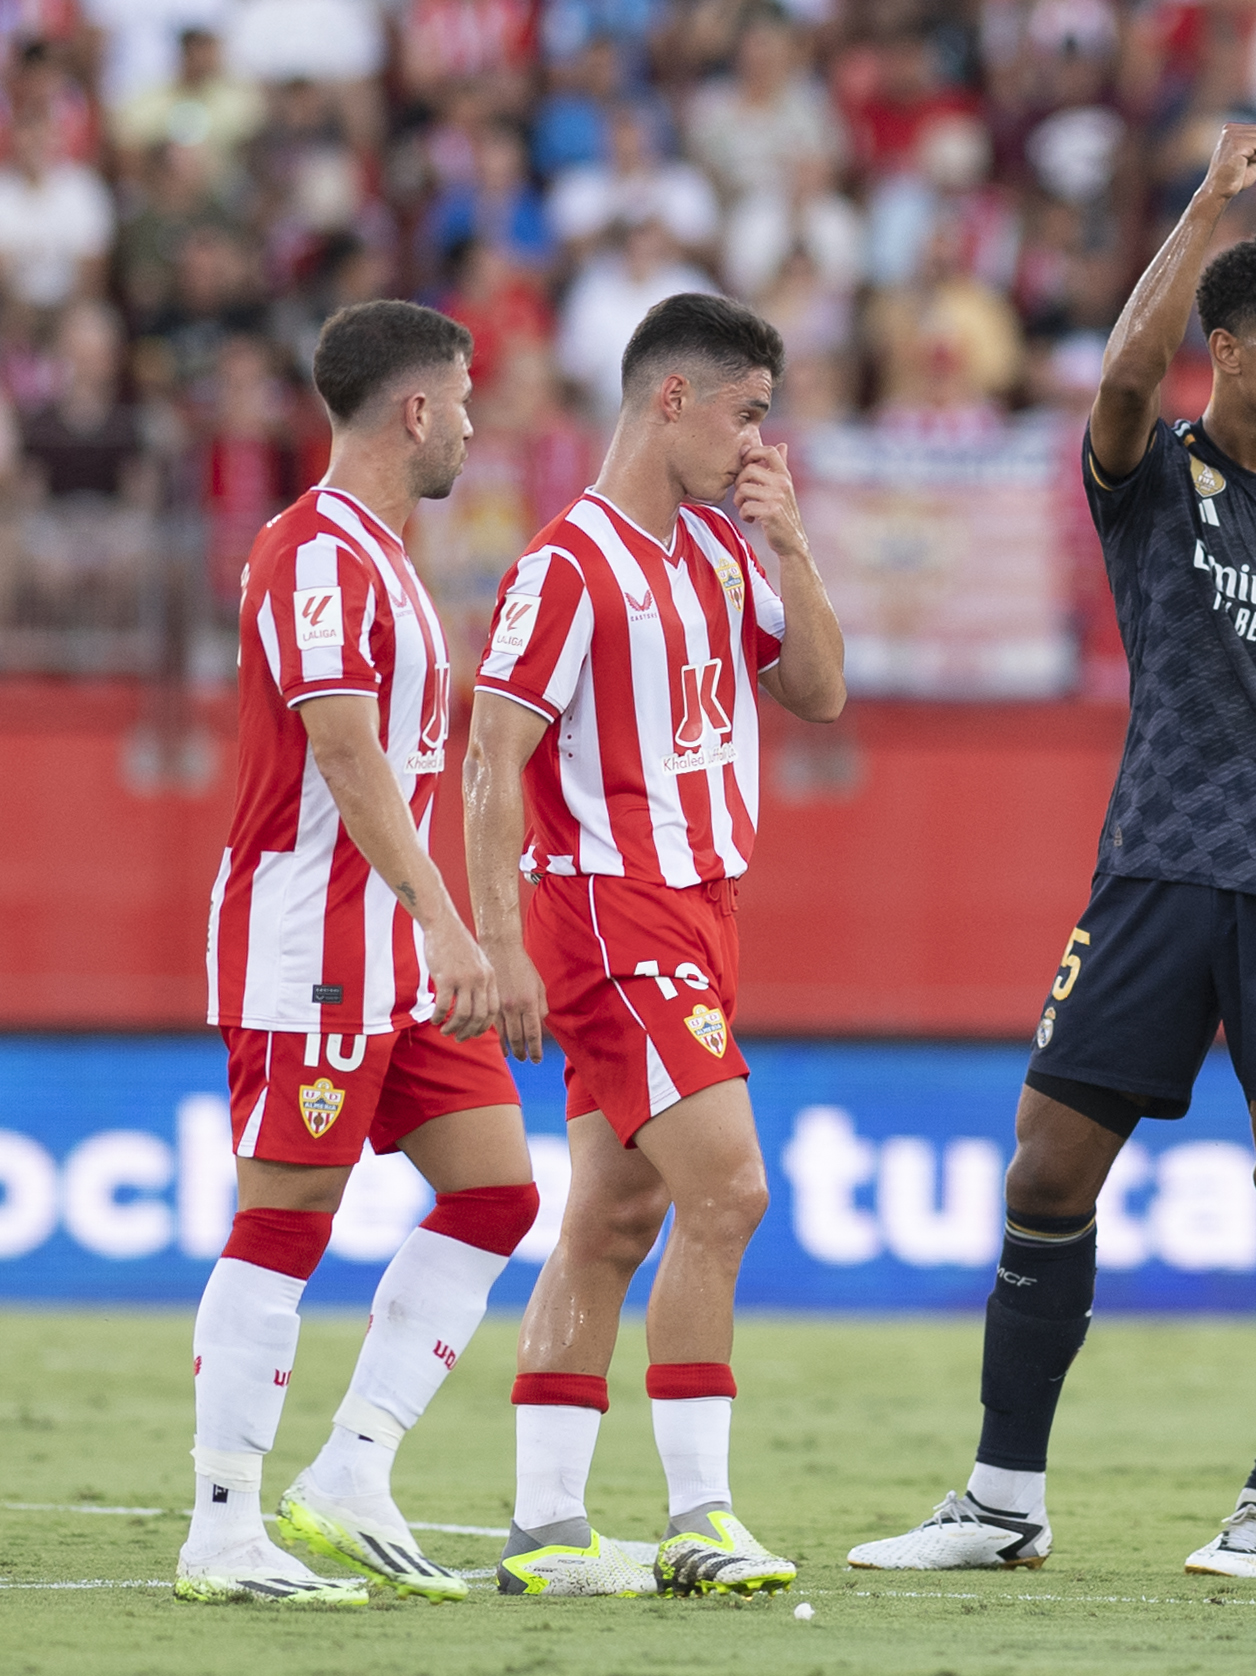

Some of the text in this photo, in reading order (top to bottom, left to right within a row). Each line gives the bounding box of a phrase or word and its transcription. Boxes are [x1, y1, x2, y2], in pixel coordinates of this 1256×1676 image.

[303, 629, 337, 641] LALIGA
[496, 634, 524, 647] LALIGA
[662, 750, 705, 773] Khaled
[1052, 927, 1090, 1001] 5
[780, 1105, 1002, 1267] tu
